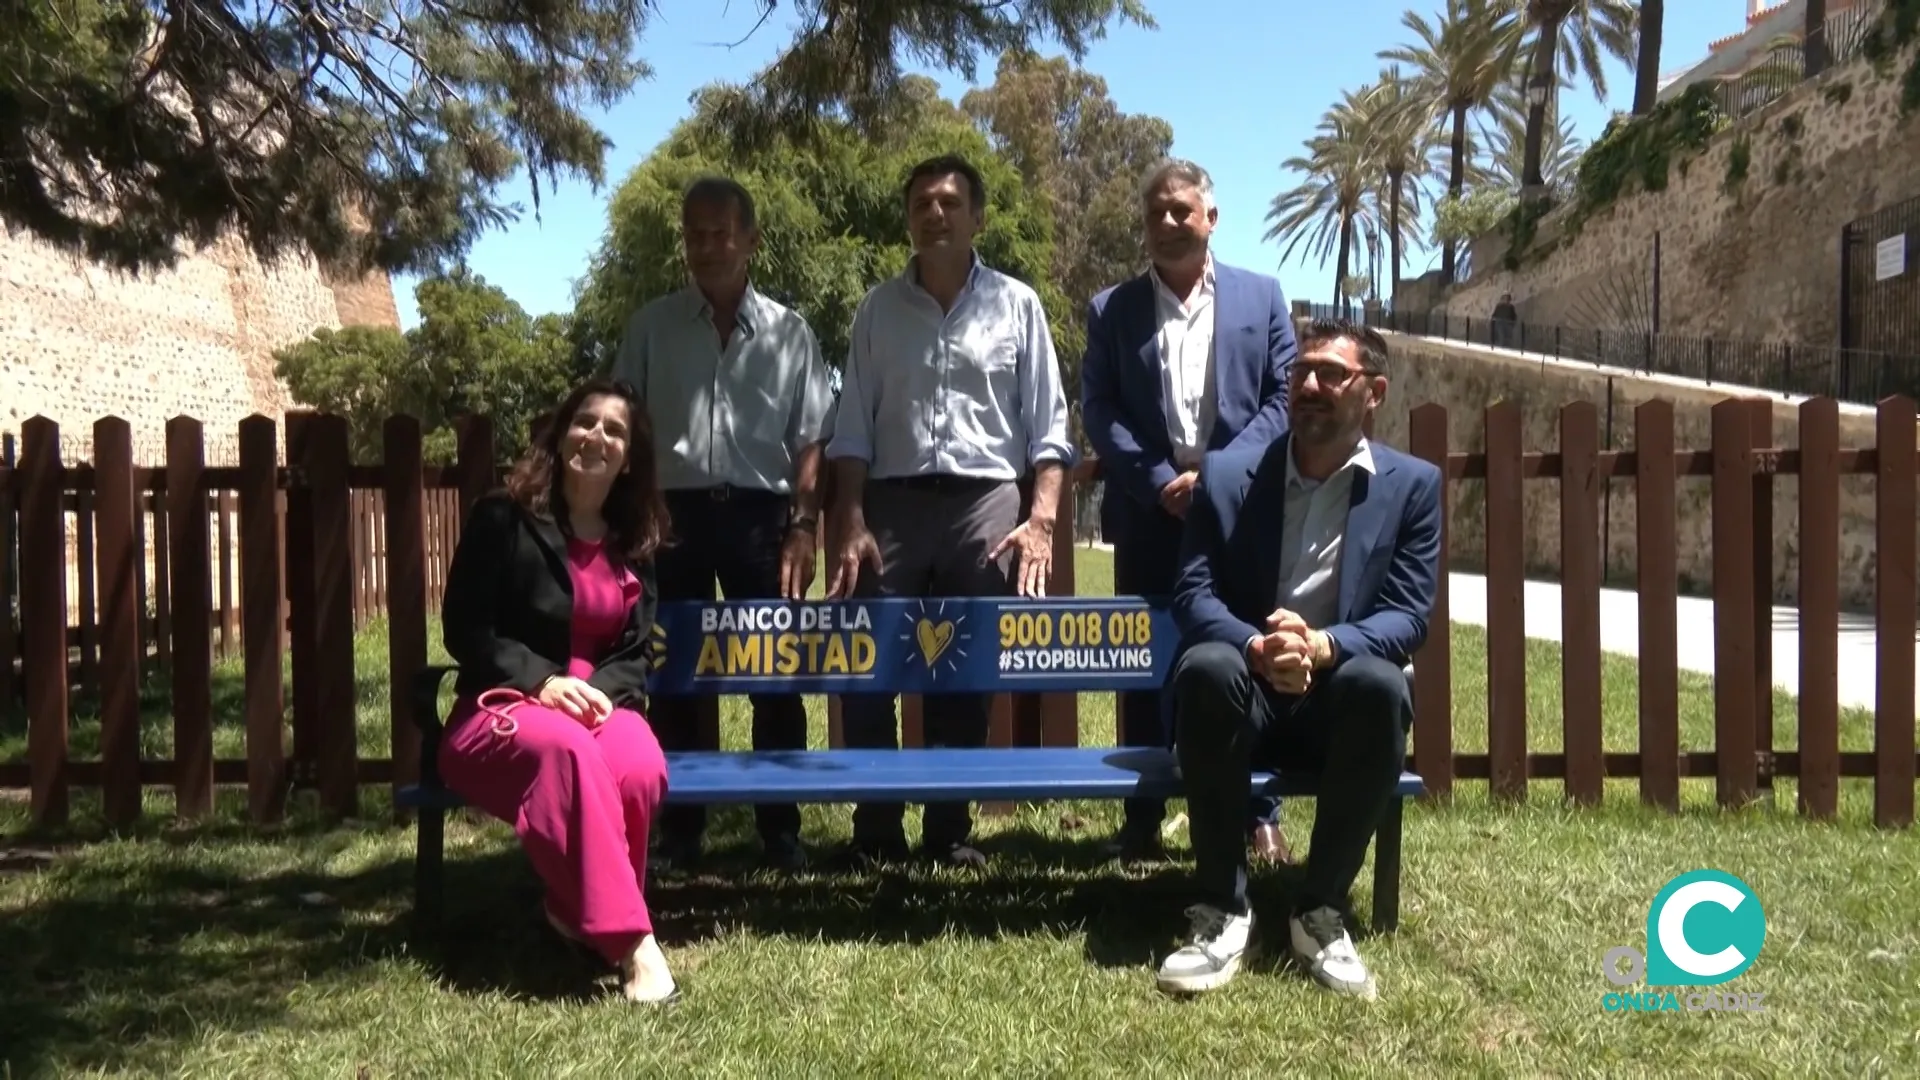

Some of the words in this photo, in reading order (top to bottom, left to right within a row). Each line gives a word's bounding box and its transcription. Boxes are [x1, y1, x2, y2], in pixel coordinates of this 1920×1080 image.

[702, 606, 793, 631] BANCO
[800, 605, 833, 630] DE
[840, 605, 872, 630] LA
[999, 612, 1053, 648] 900
[1059, 612, 1102, 647] 018
[1108, 611, 1151, 646] 018
[695, 632, 876, 675] AMISTAD
[998, 648, 1153, 671] #STOPBULLYING
